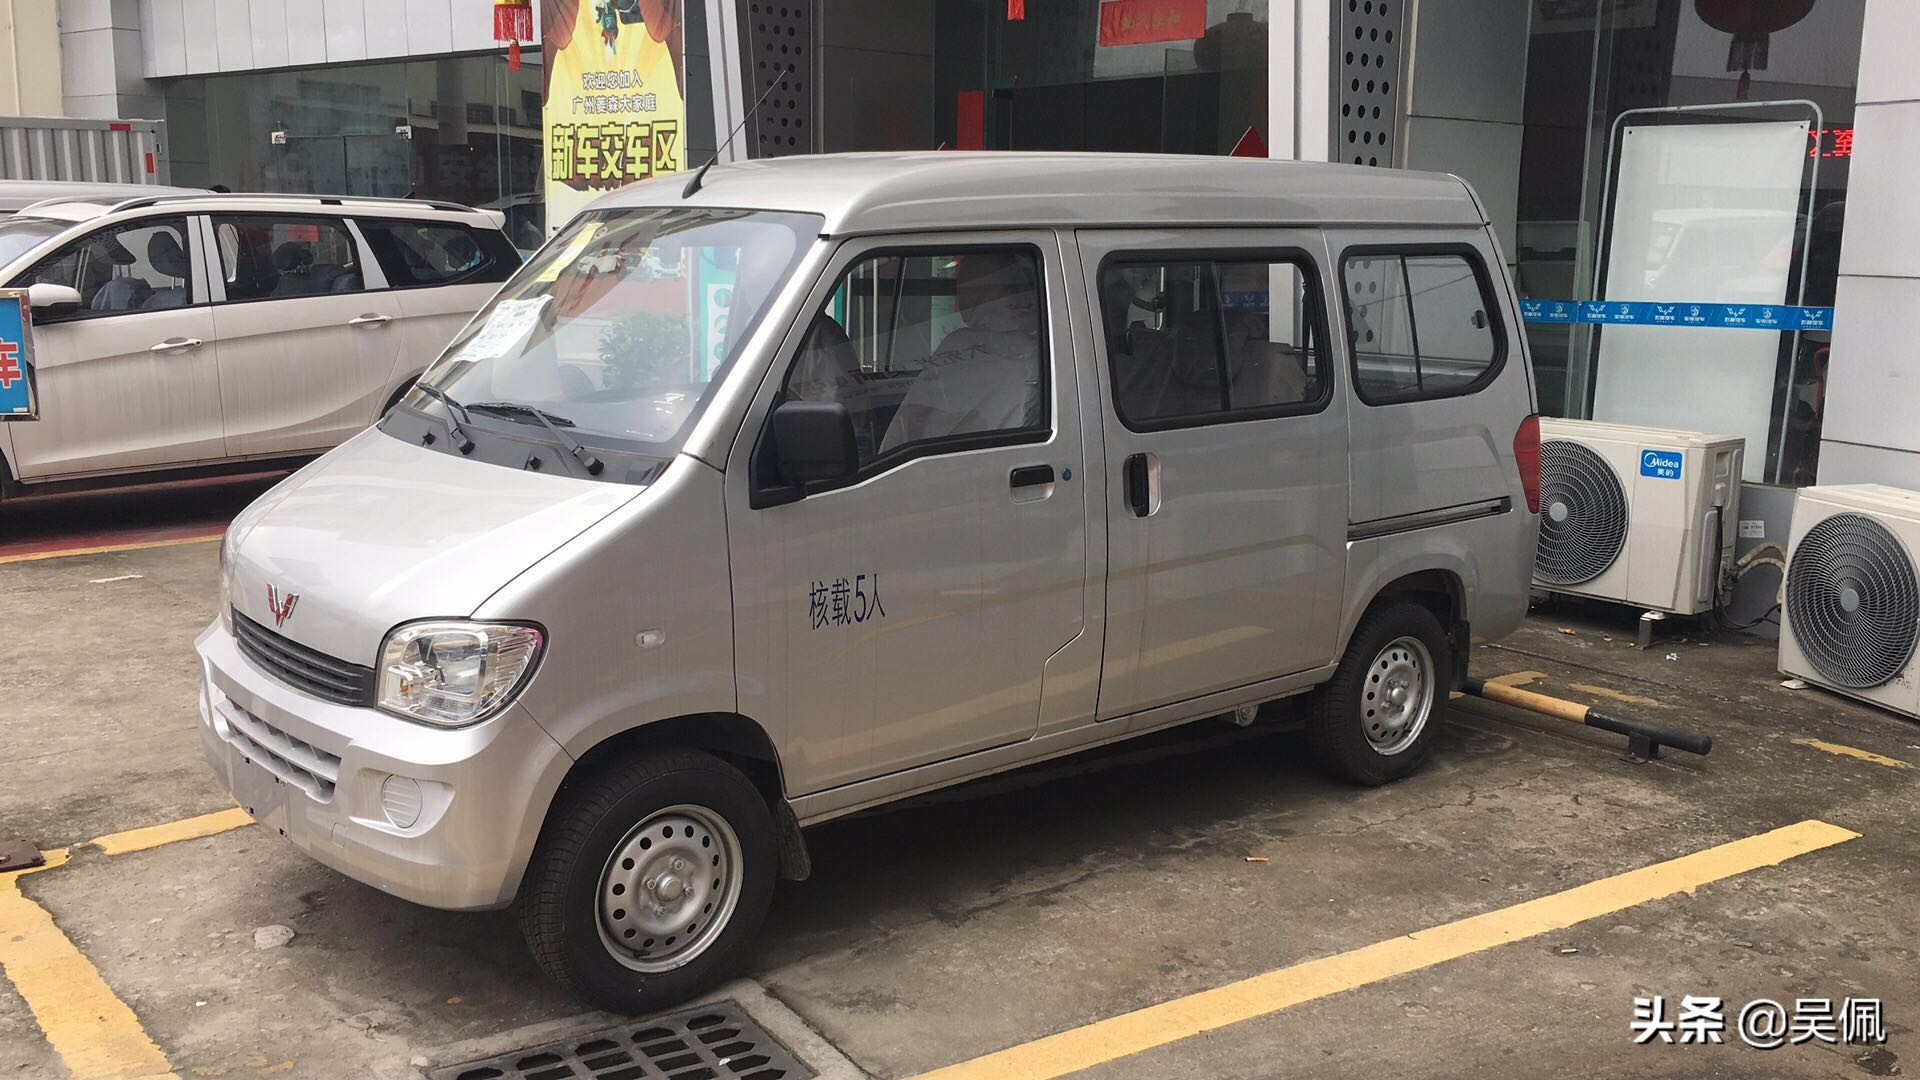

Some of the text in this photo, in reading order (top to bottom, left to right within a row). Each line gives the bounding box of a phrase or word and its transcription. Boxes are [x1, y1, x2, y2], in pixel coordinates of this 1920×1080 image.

[582, 69, 643, 91] 欢迎您加入
[572, 92, 657, 115] 广州菱森大家庭
[551, 119, 678, 181] 新车交车区
[1643, 452, 1679, 468] Midea
[1657, 468, 1674, 477] 美的
[809, 573, 886, 630] 核载5人
